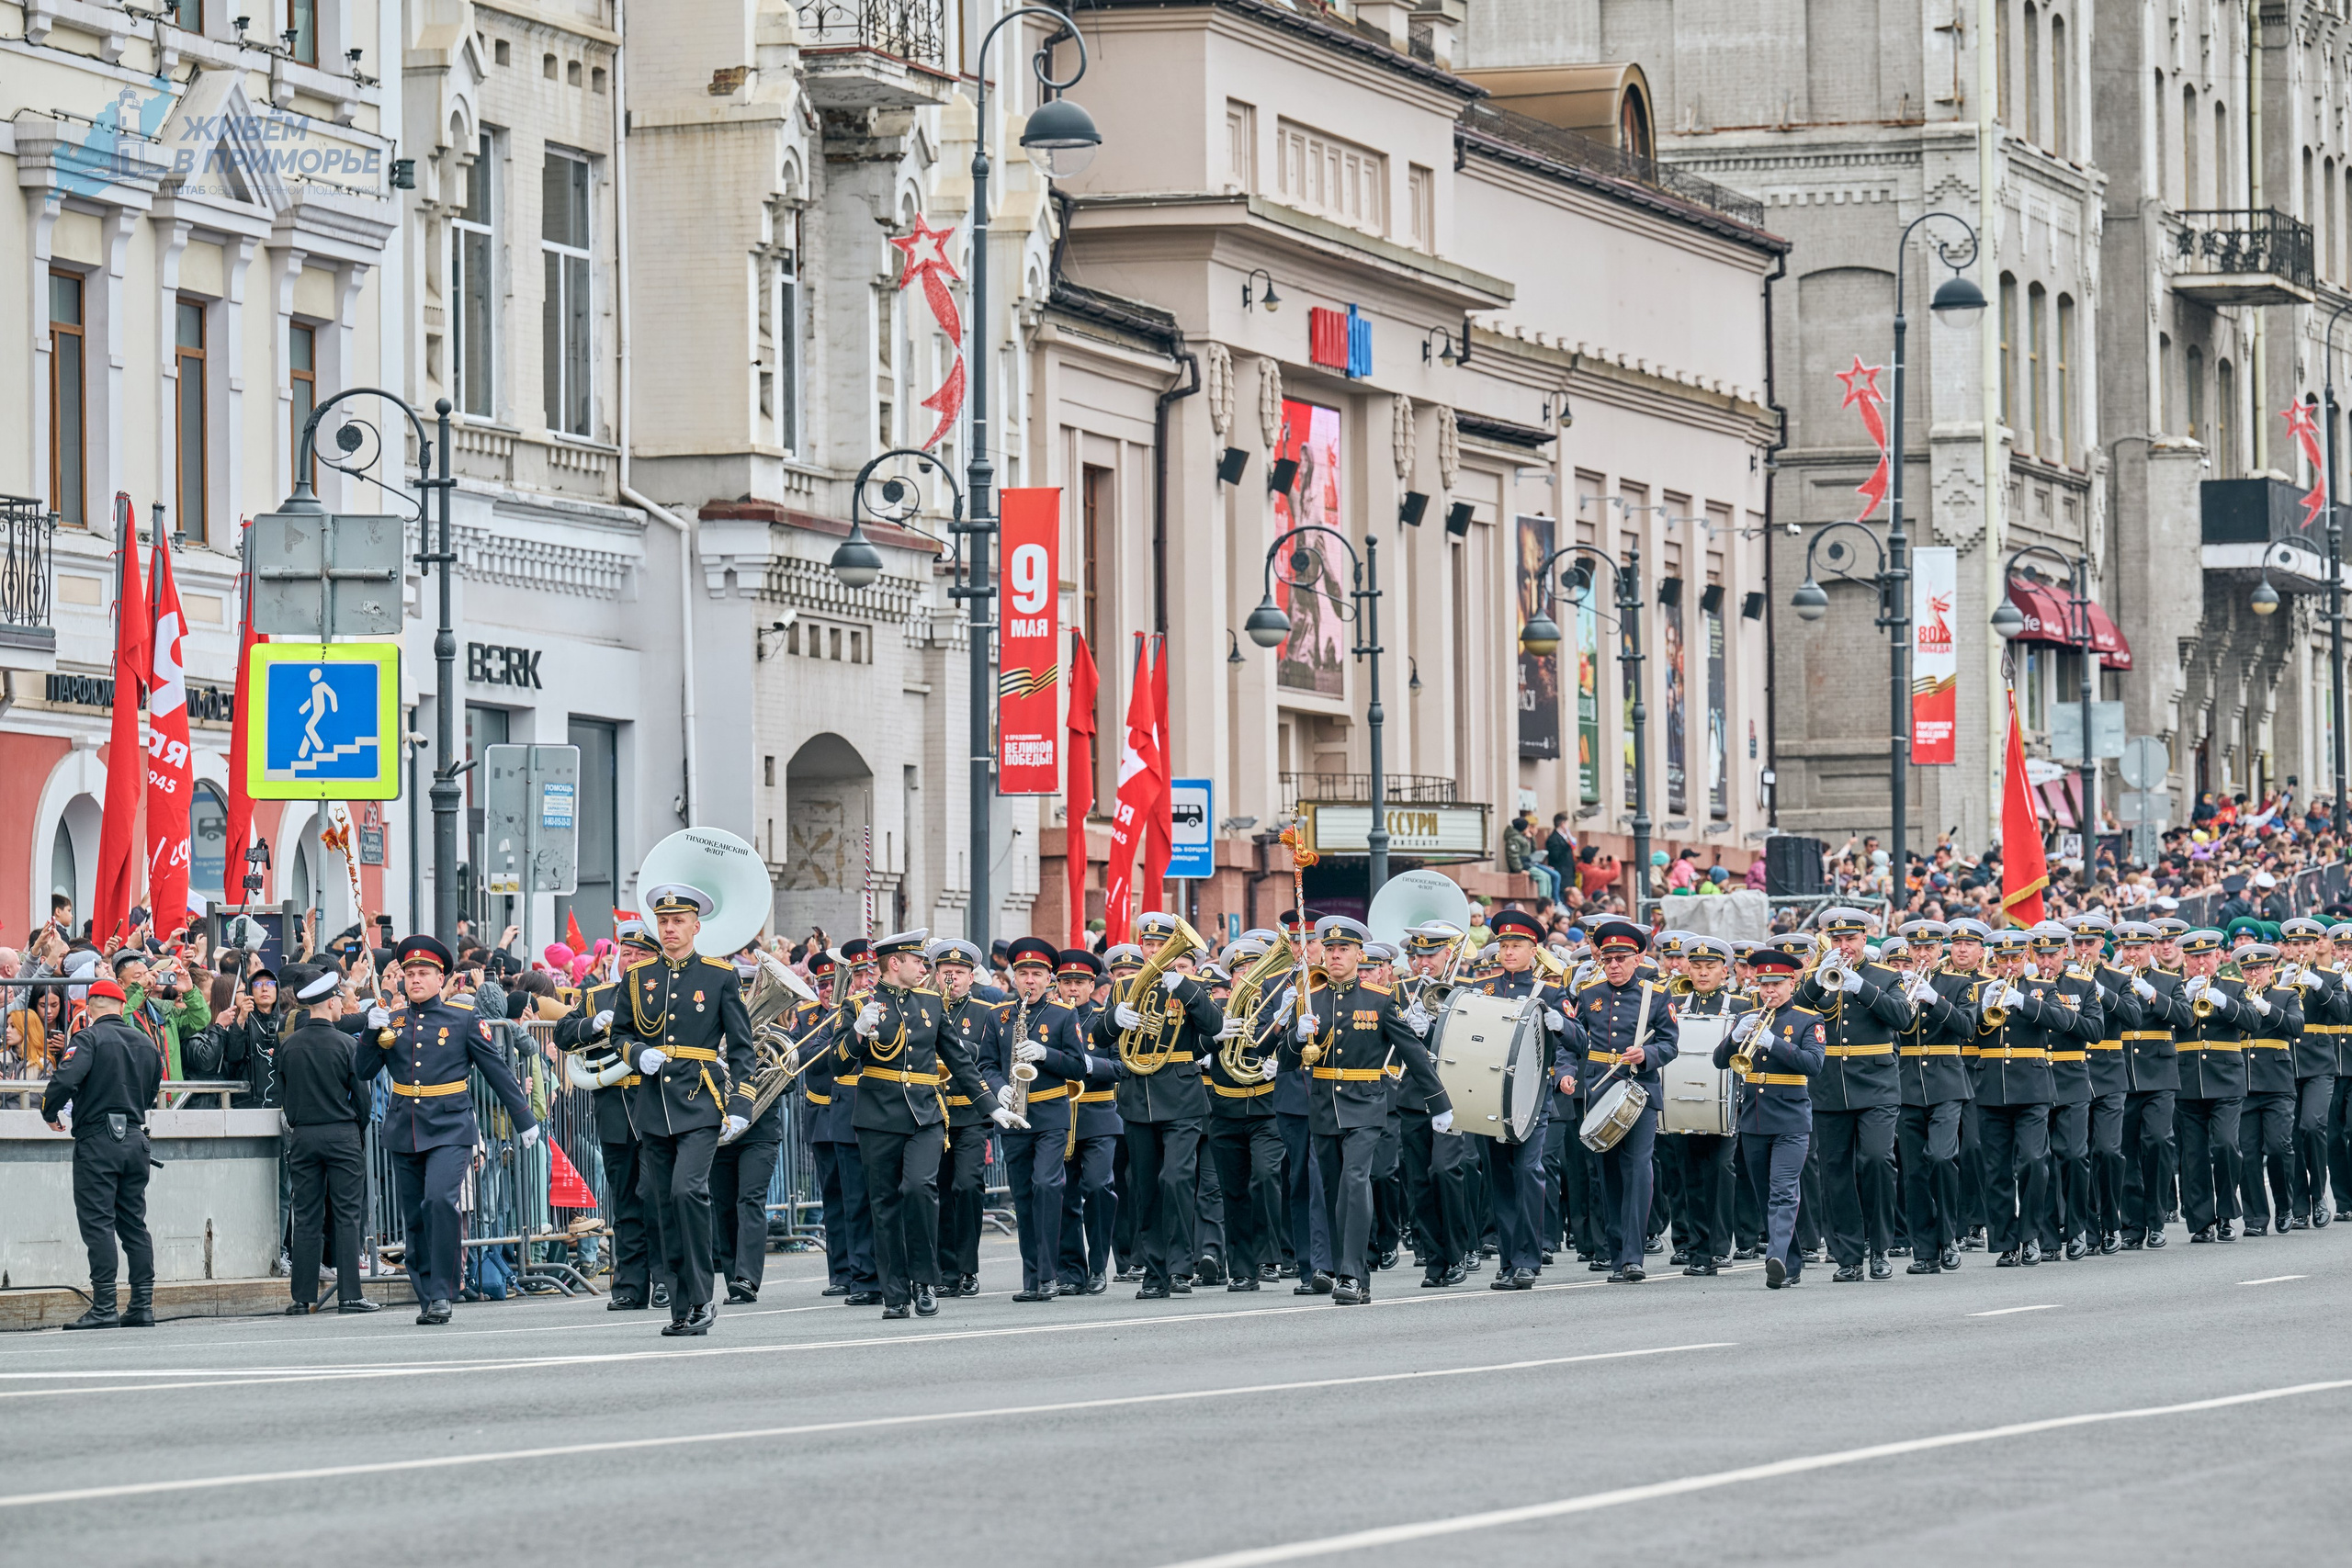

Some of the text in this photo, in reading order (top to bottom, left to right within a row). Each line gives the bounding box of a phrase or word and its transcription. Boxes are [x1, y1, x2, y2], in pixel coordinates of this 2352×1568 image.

[1012, 543, 1048, 615] 9
[1011, 618, 1048, 637] МАЯ
[1918, 626, 1937, 643] 80
[1005, 739, 1053, 753] ВЕЛИКОЙ
[1005, 753, 1053, 767] ПОБЕДЫ!
[545, 784, 573, 793] ПОМОЩЬ
[368, 807, 377, 827] 29
[1383, 811, 1439, 836] ССУРИ
[685, 833, 749, 856] ТИХООКЕАНСКИЙ
[704, 847, 726, 857] ФЛОТ
